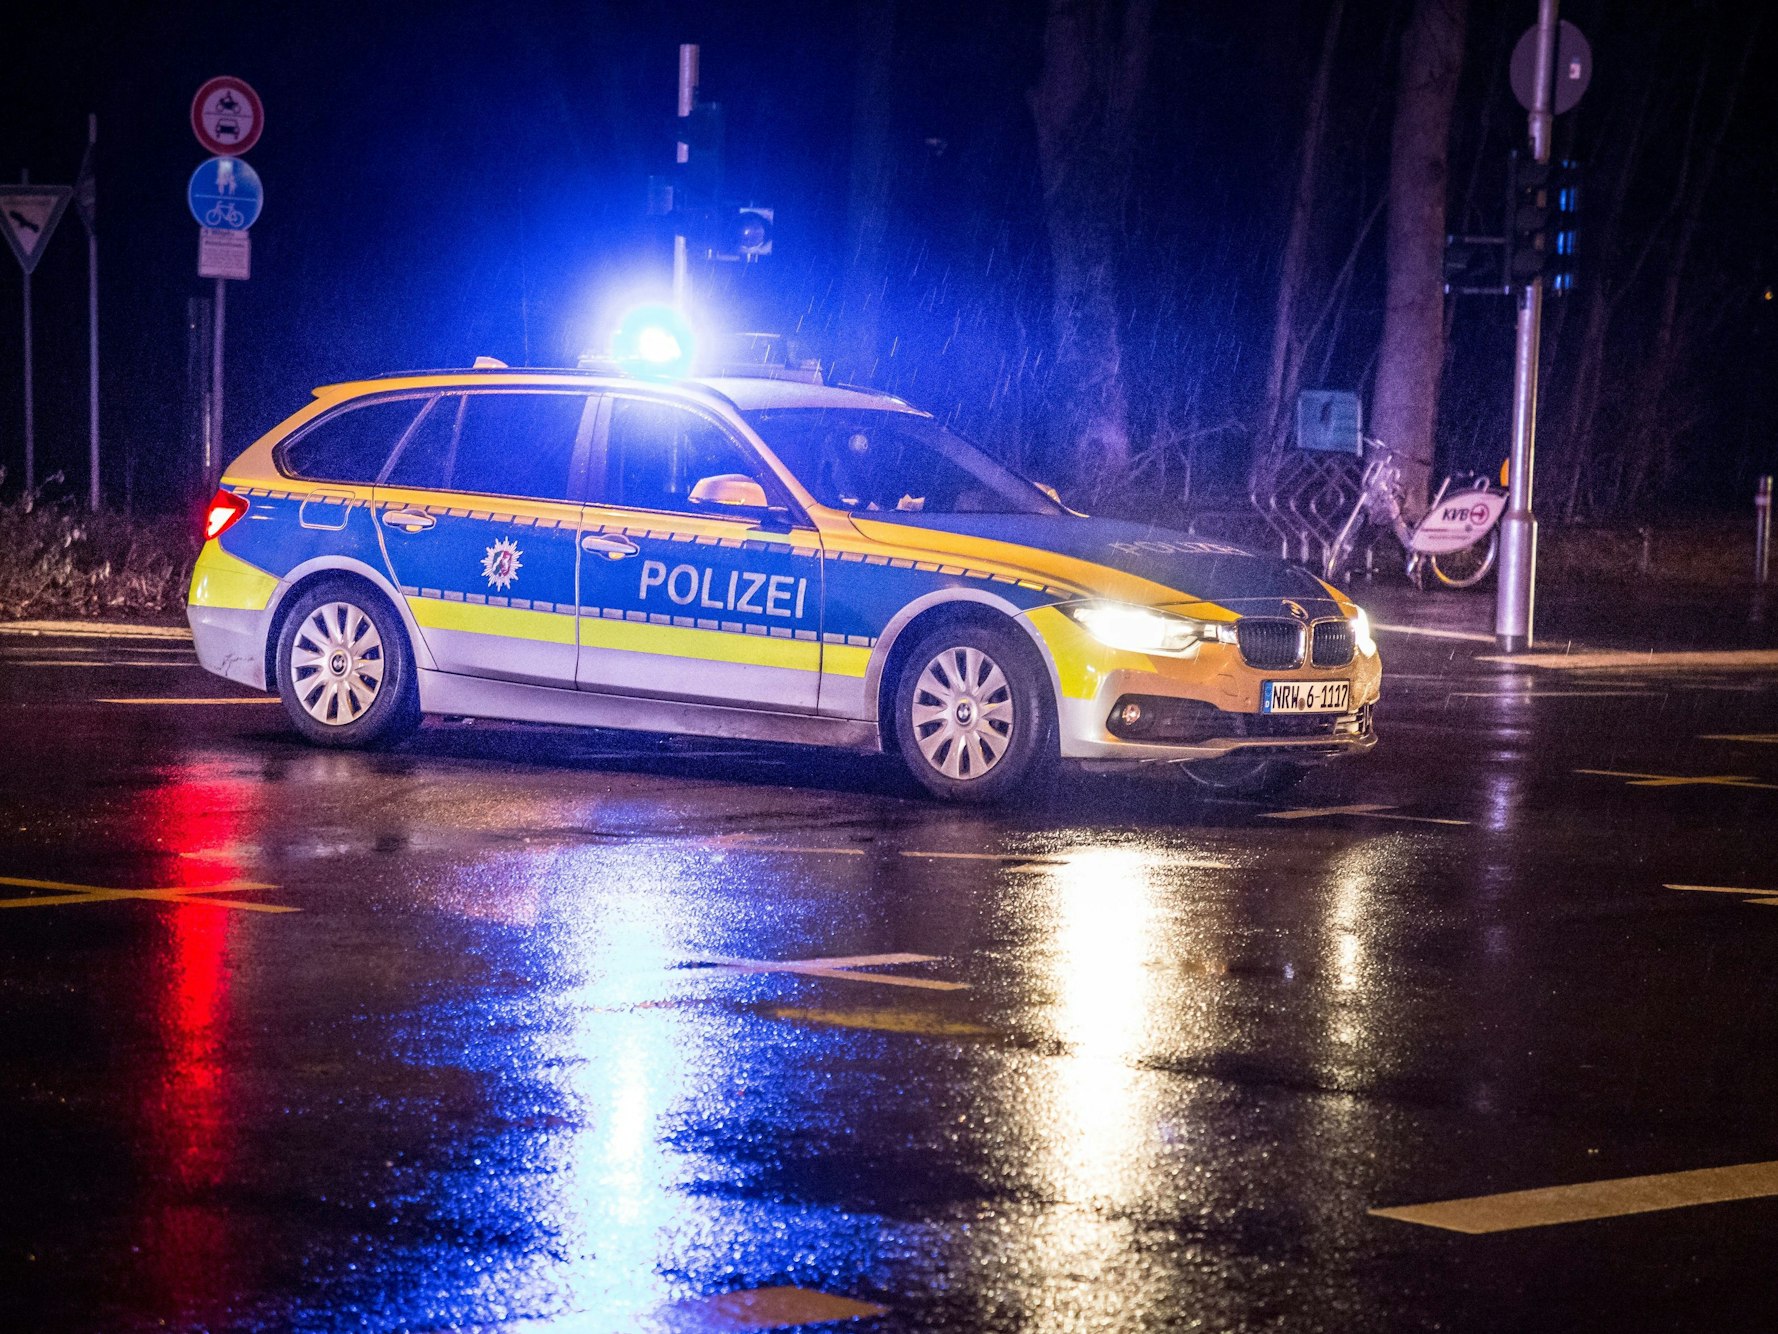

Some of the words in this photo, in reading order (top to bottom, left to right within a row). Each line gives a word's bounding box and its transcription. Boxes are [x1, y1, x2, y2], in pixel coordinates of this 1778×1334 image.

[1442, 508, 1470, 521] KVB
[639, 559, 807, 619] POLIZEI
[1273, 686, 1300, 709] NRW
[1307, 685, 1349, 709] 6-1117
